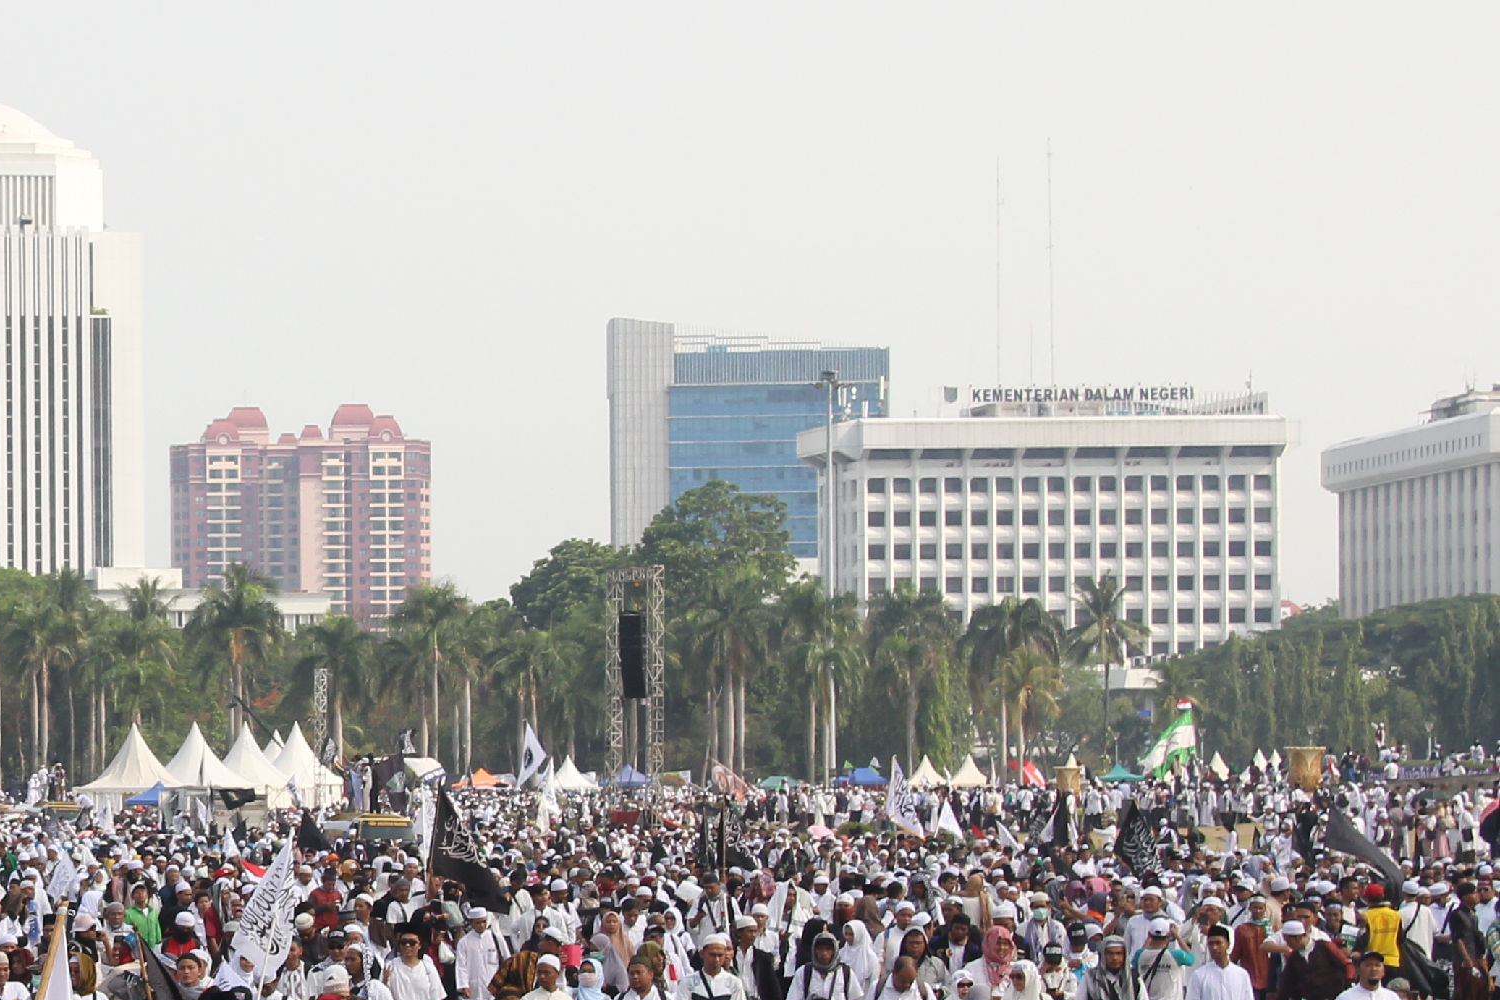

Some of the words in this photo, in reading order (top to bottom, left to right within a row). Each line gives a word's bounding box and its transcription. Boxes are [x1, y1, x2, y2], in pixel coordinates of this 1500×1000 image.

[972, 388, 1080, 402] KEMENTERIAN
[1084, 387, 1135, 402] DALAM
[1139, 386, 1195, 401] NEGERI
